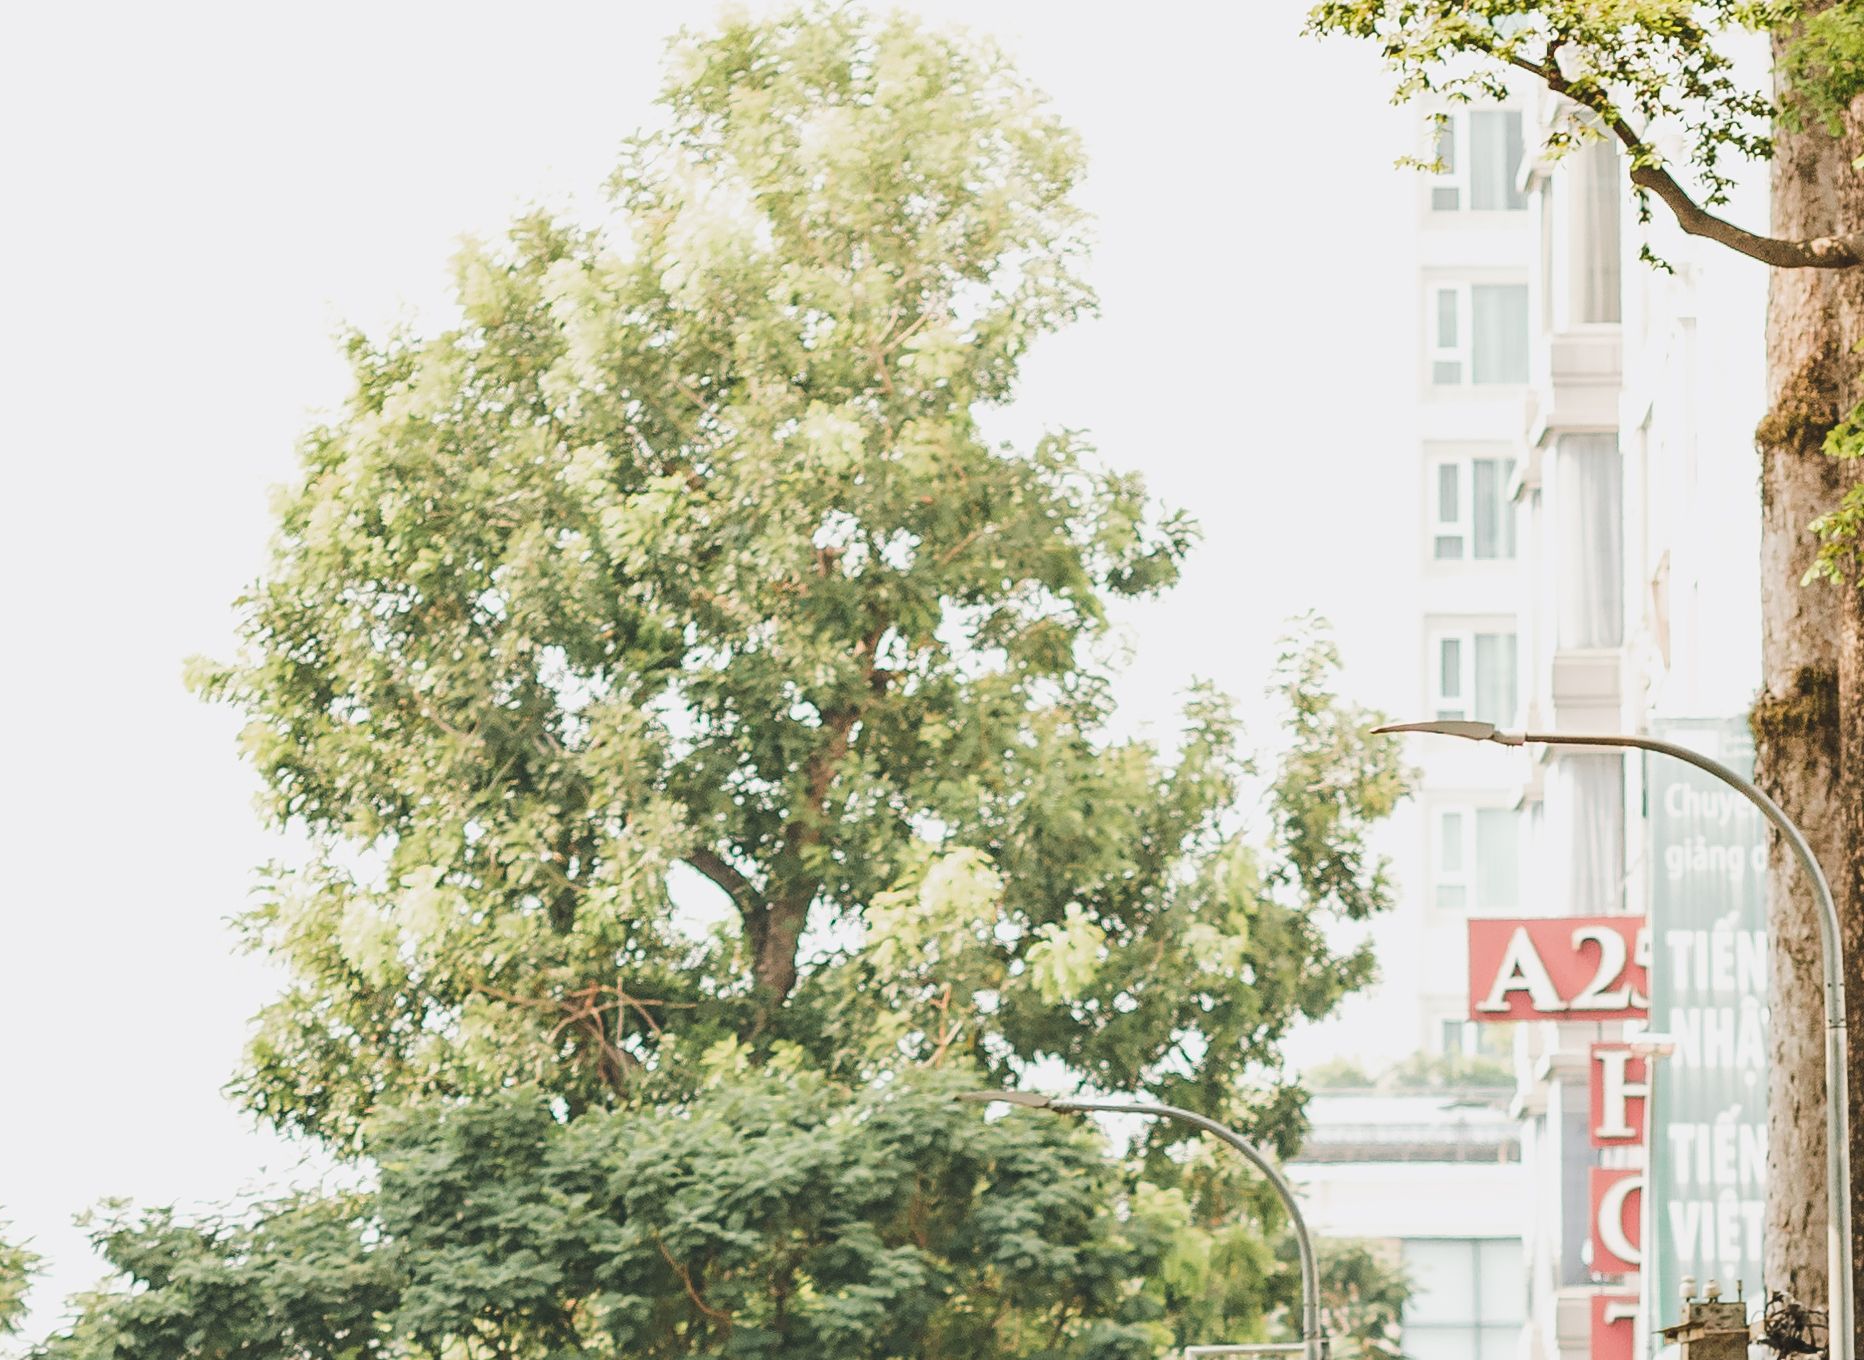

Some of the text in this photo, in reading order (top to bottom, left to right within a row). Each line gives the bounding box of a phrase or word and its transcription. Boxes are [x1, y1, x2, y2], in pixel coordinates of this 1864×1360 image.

[1664, 835, 1744, 881] giảng
[1666, 910, 1768, 991] TIẾN
[1670, 996, 1769, 1088] NHẬ
[1667, 1103, 1768, 1185] TIẾN
